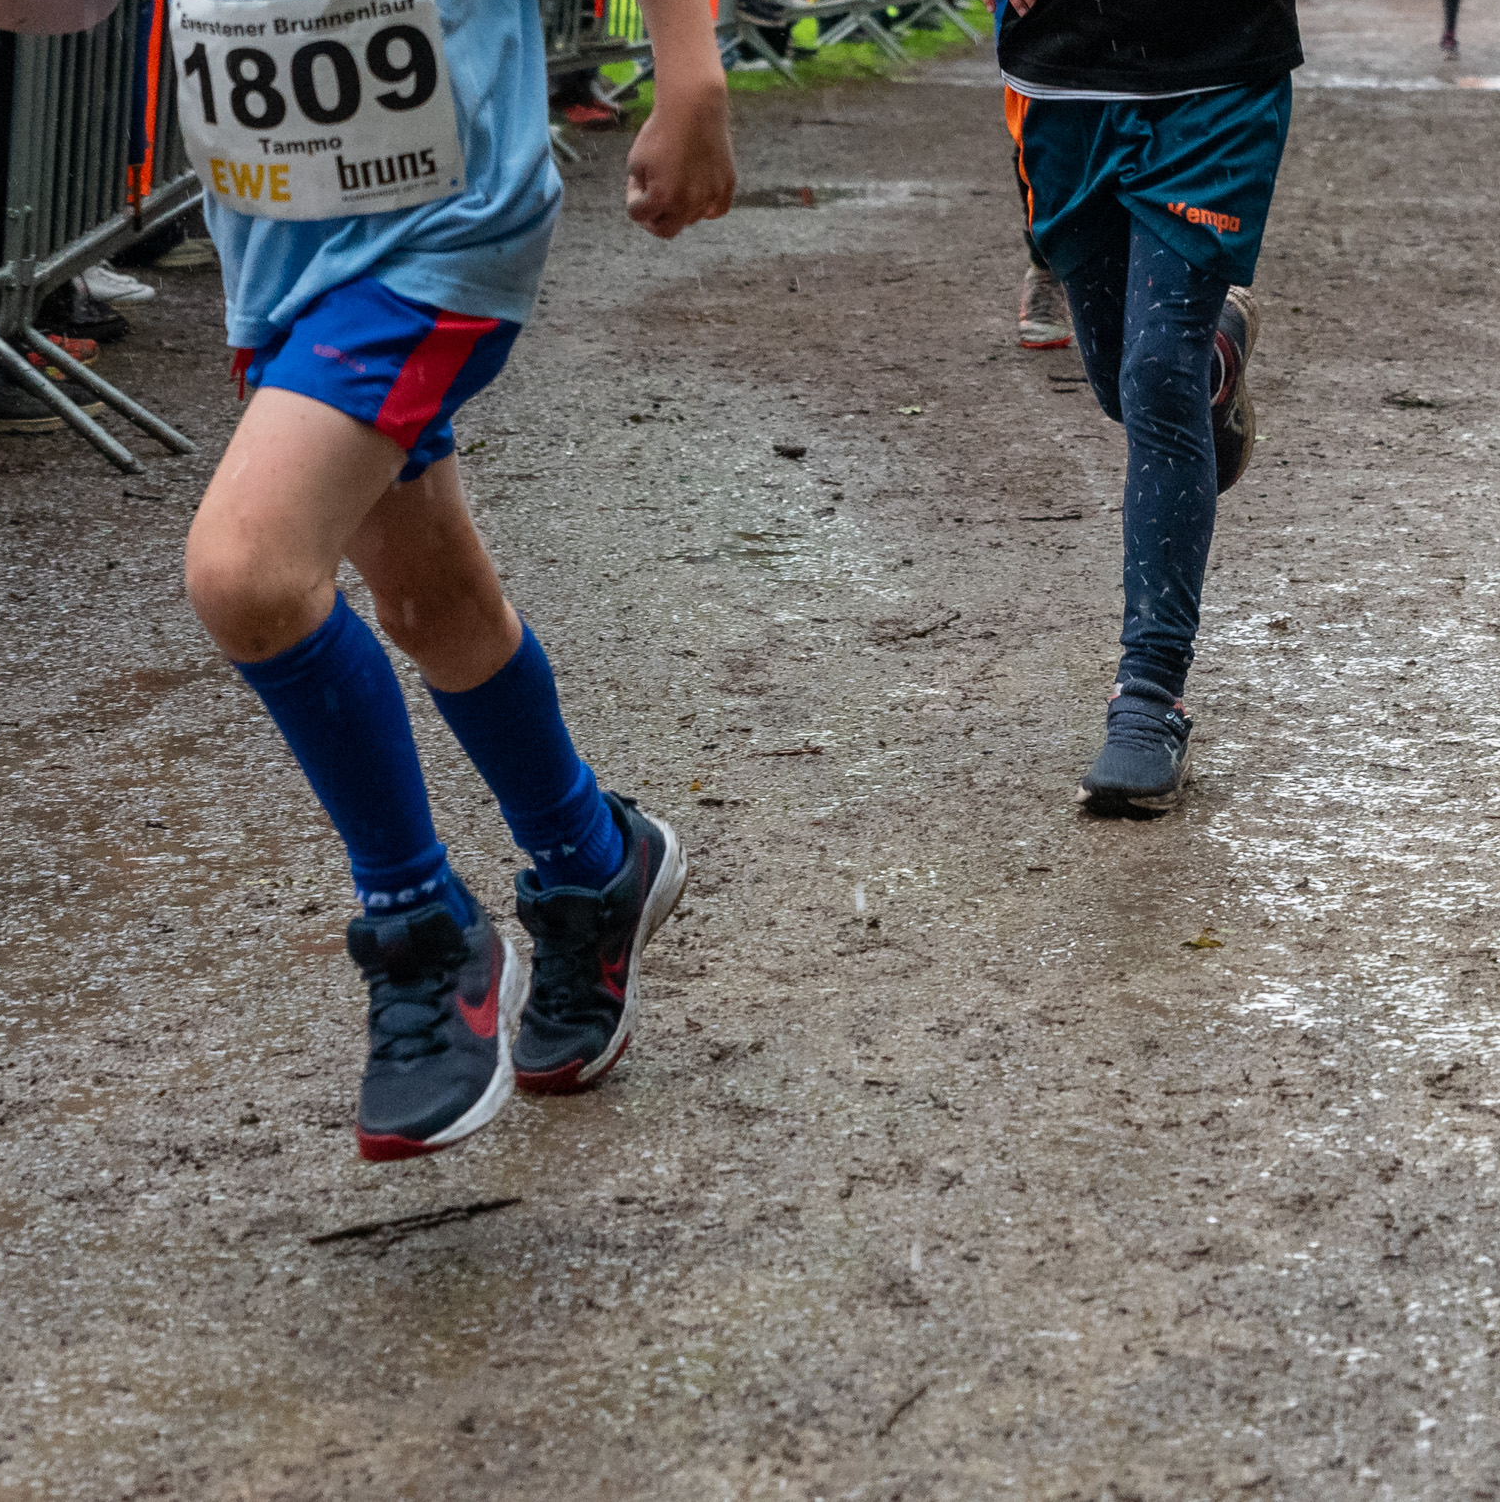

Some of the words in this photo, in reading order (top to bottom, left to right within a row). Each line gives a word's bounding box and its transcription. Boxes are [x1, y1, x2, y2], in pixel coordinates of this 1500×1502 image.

[183, 25, 437, 130] 1809
[259, 137, 343, 155] Tammo
[210, 157, 292, 202] EWE
[336, 148, 437, 190] bruns
